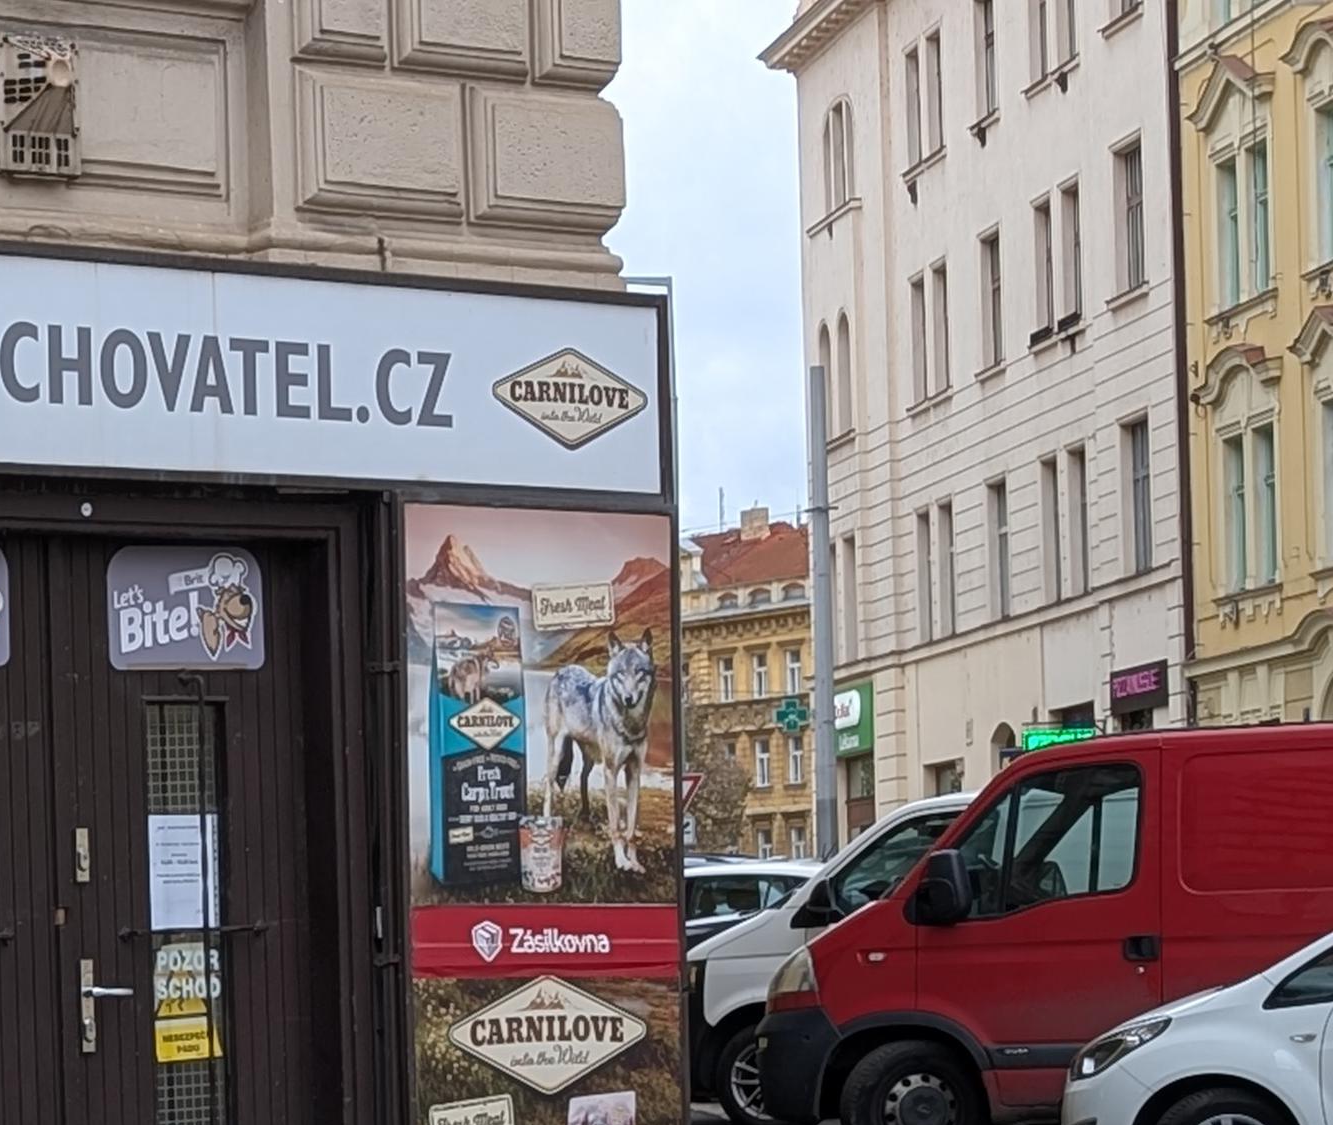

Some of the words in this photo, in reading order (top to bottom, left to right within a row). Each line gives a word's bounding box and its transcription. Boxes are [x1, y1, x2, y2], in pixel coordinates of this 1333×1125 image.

[509, 380, 630, 410] CARNILOVE
[183, 574, 204, 587] Brit
[113, 584, 144, 609] Let's
[540, 597, 573, 617] Fresh
[574, 595, 607, 615] Meat
[119, 590, 200, 654] Bite!
[456, 714, 515, 729] CARNILOVE
[508, 927, 611, 954] Zásilkovna
[156, 947, 220, 972] POZOR
[156, 975, 222, 999] SCHOD
[469, 1014, 625, 1047] CARNILOVE
[552, 1043, 591, 1066] Wild
